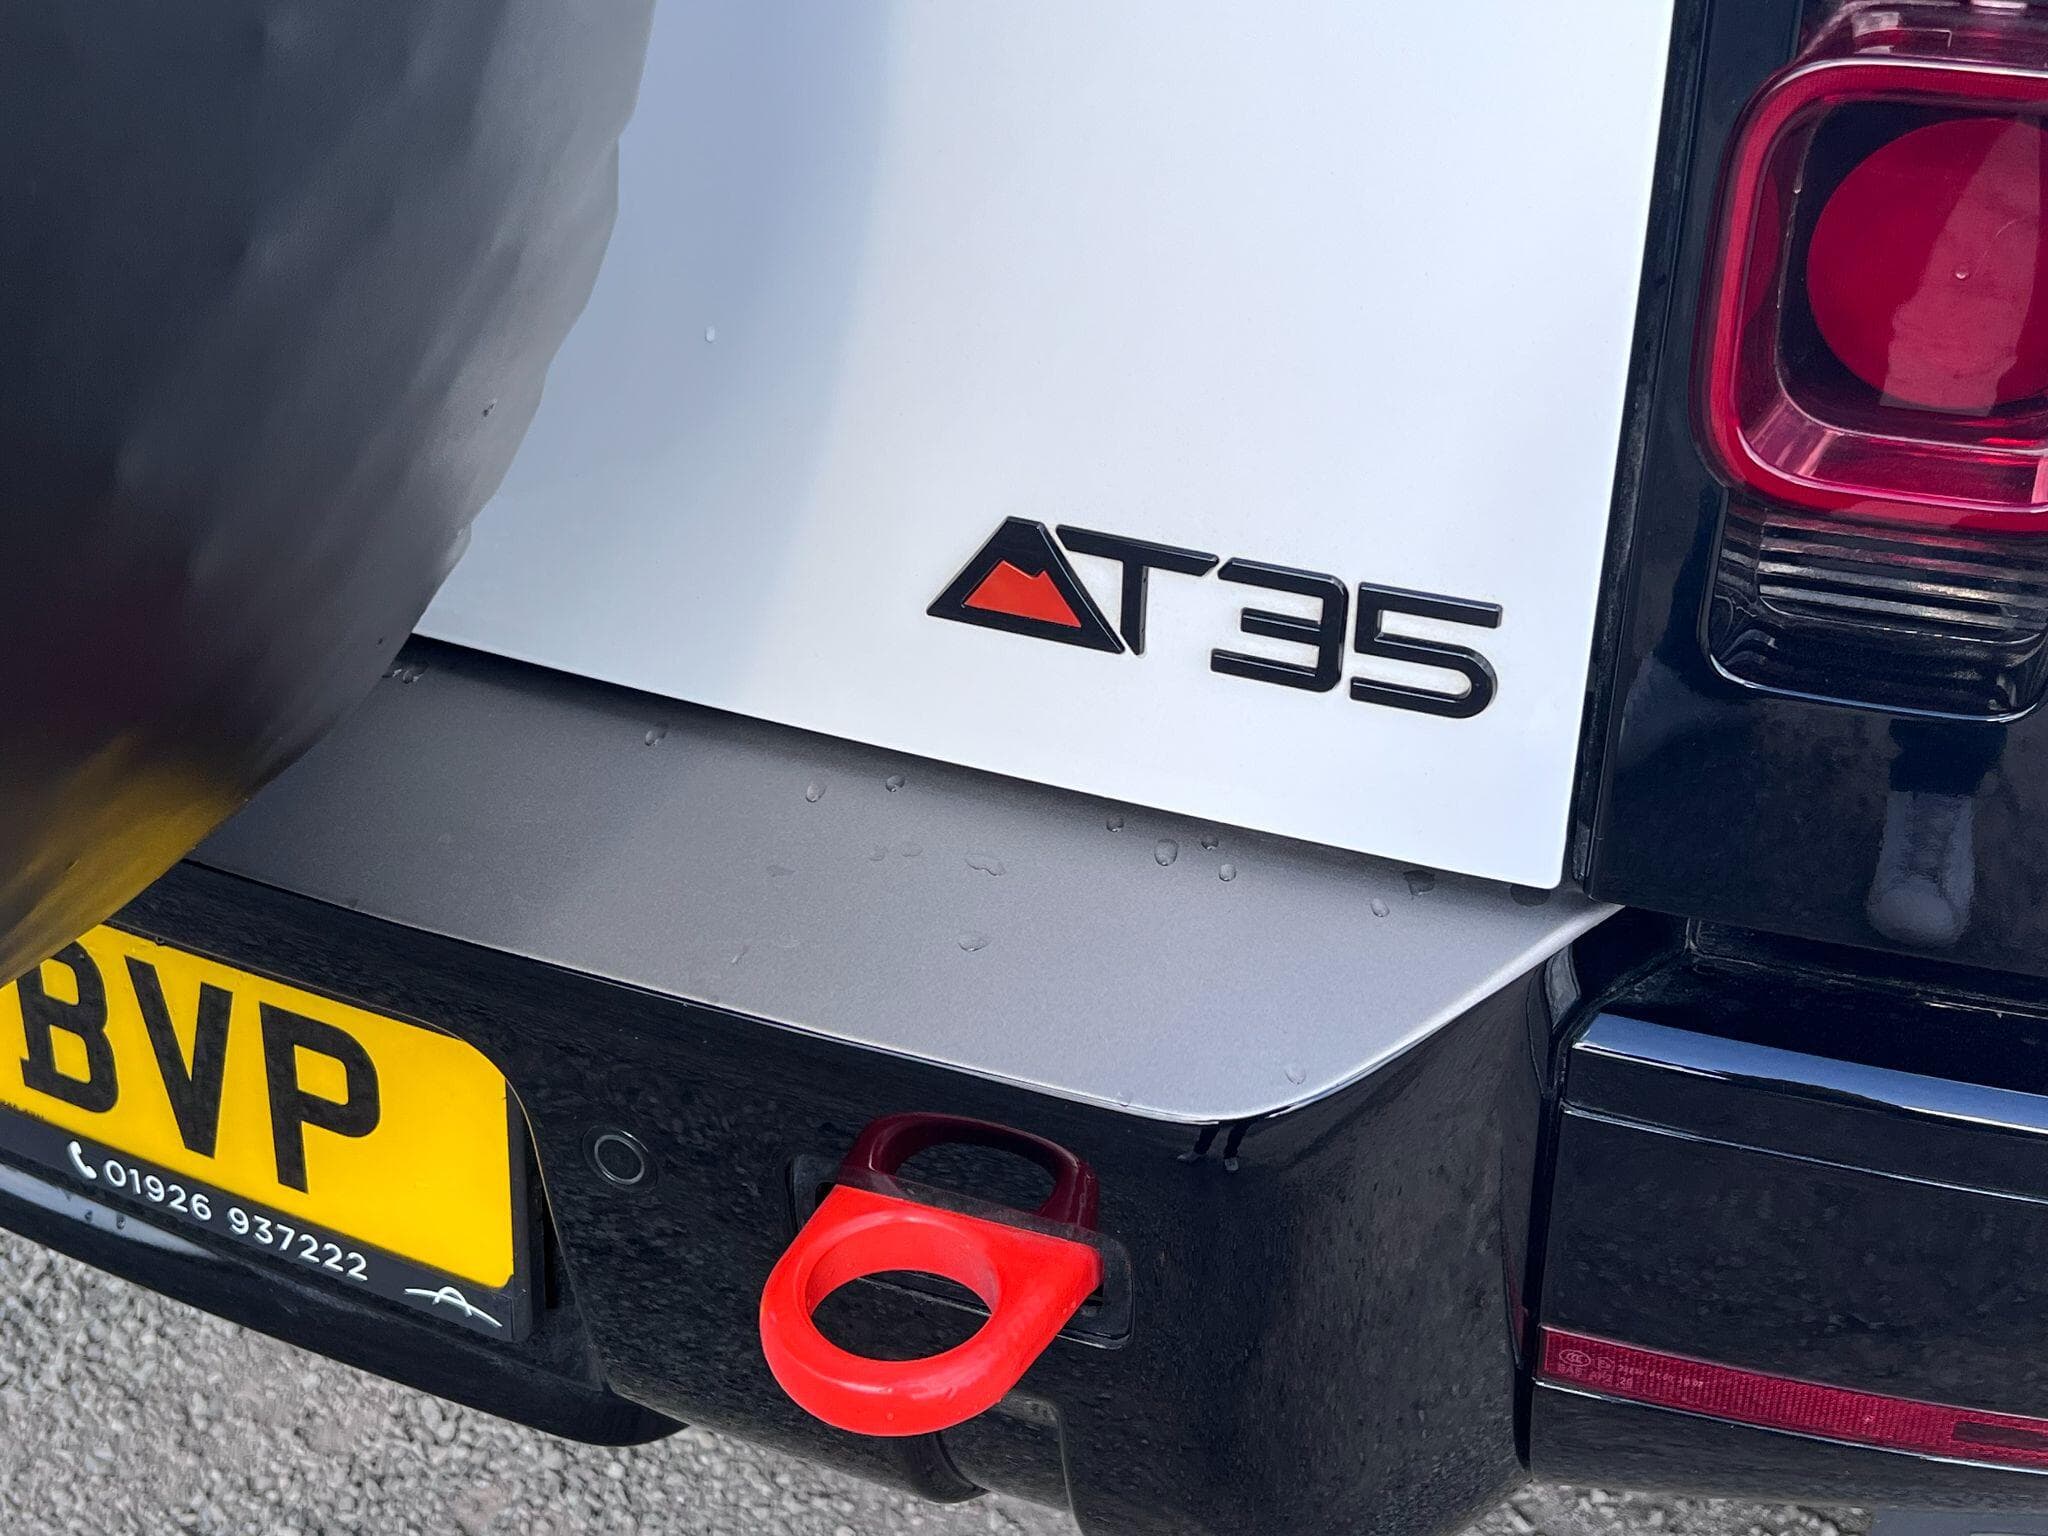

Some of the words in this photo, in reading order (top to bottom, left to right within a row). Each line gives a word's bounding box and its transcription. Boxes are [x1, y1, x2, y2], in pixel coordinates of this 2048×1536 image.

[926, 515, 1503, 719] AT35
[16, 939, 381, 1195] BVP
[102, 1158, 213, 1221] 01926
[226, 1206, 369, 1282] 937222
